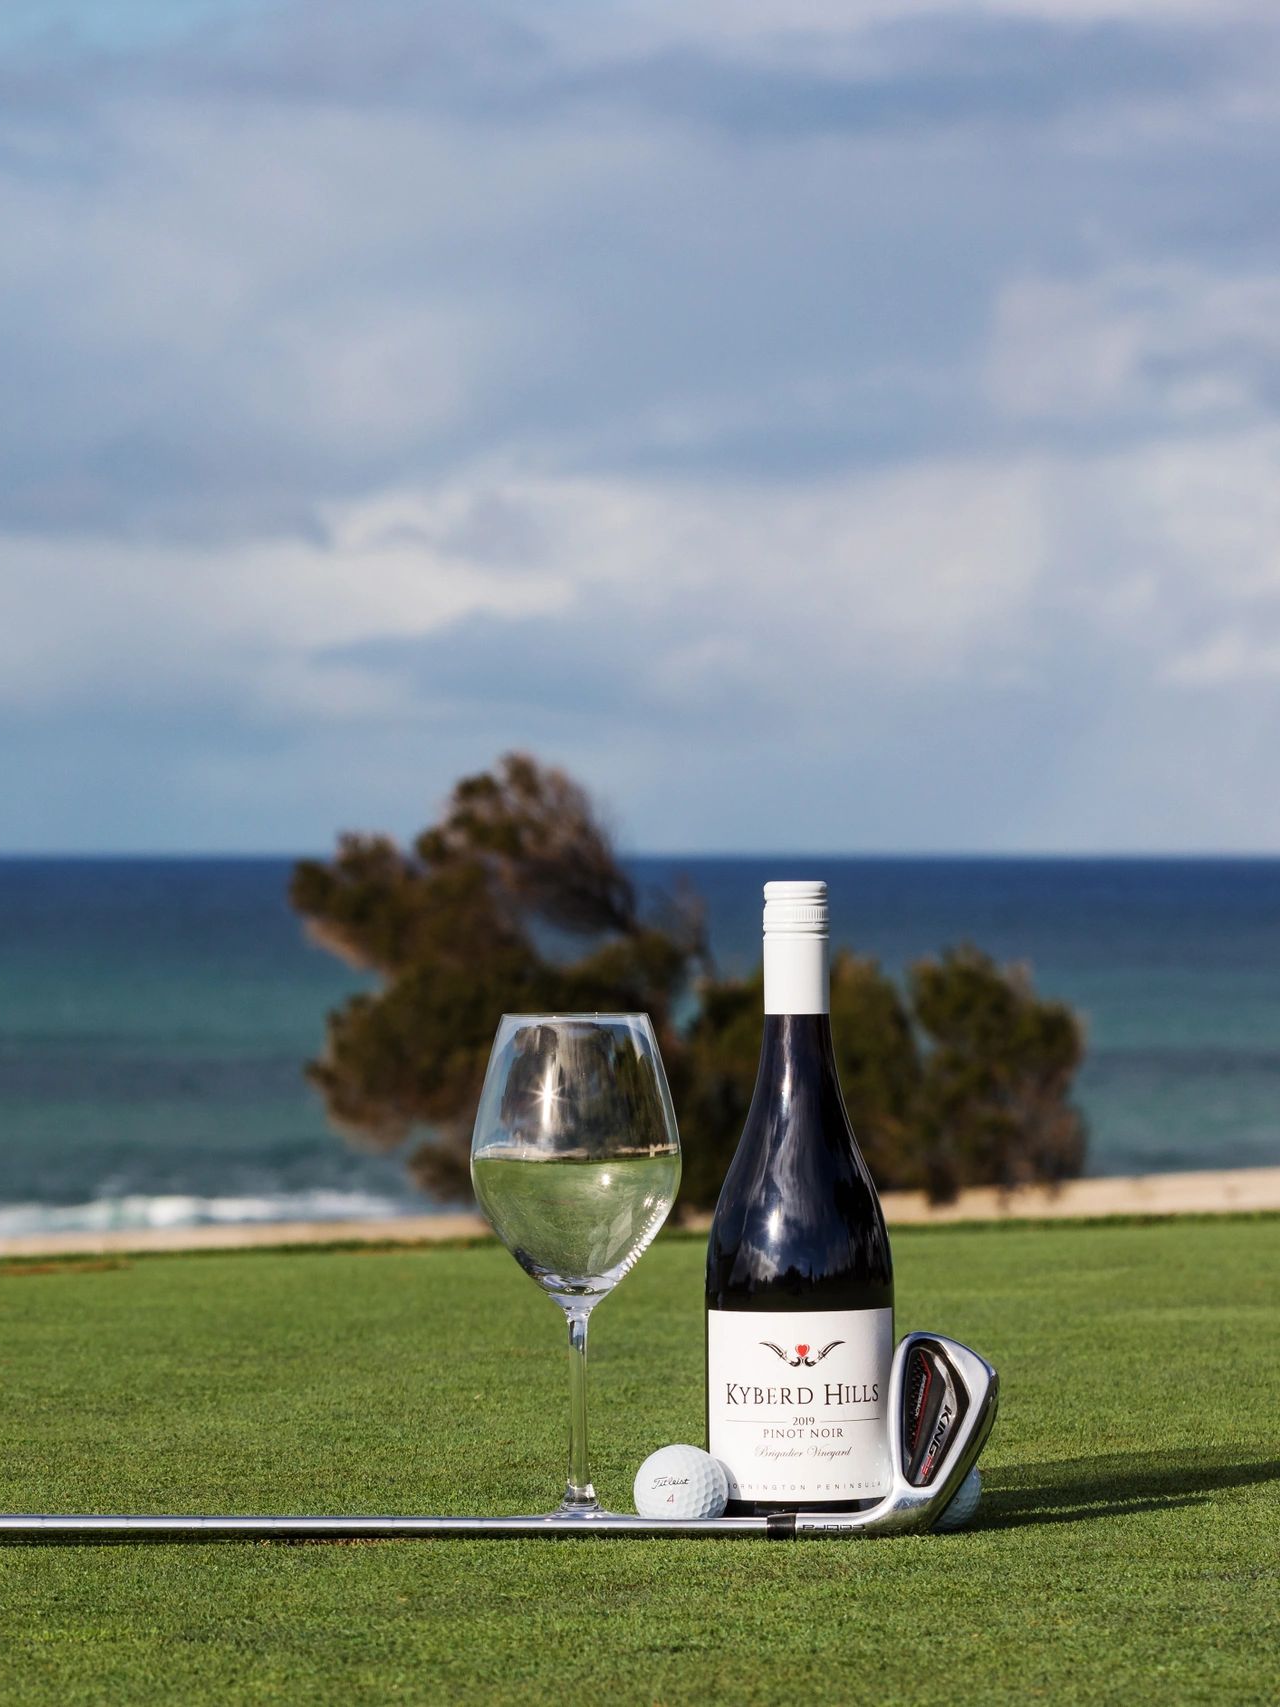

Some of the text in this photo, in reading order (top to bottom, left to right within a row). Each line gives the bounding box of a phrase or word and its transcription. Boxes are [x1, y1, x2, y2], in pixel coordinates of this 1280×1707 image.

[725, 1382, 880, 1406] KYBERD HILLS
[792, 1416, 816, 1427] 2019
[762, 1427, 845, 1439] PINOT NOIR
[928, 1403, 953, 1457] KING
[753, 1443, 853, 1461] Brigadier Vineyard
[650, 1475, 691, 1490] Titleist
[727, 1481, 807, 1491] ORNINGTON
[666, 1493, 675, 1504] 4
